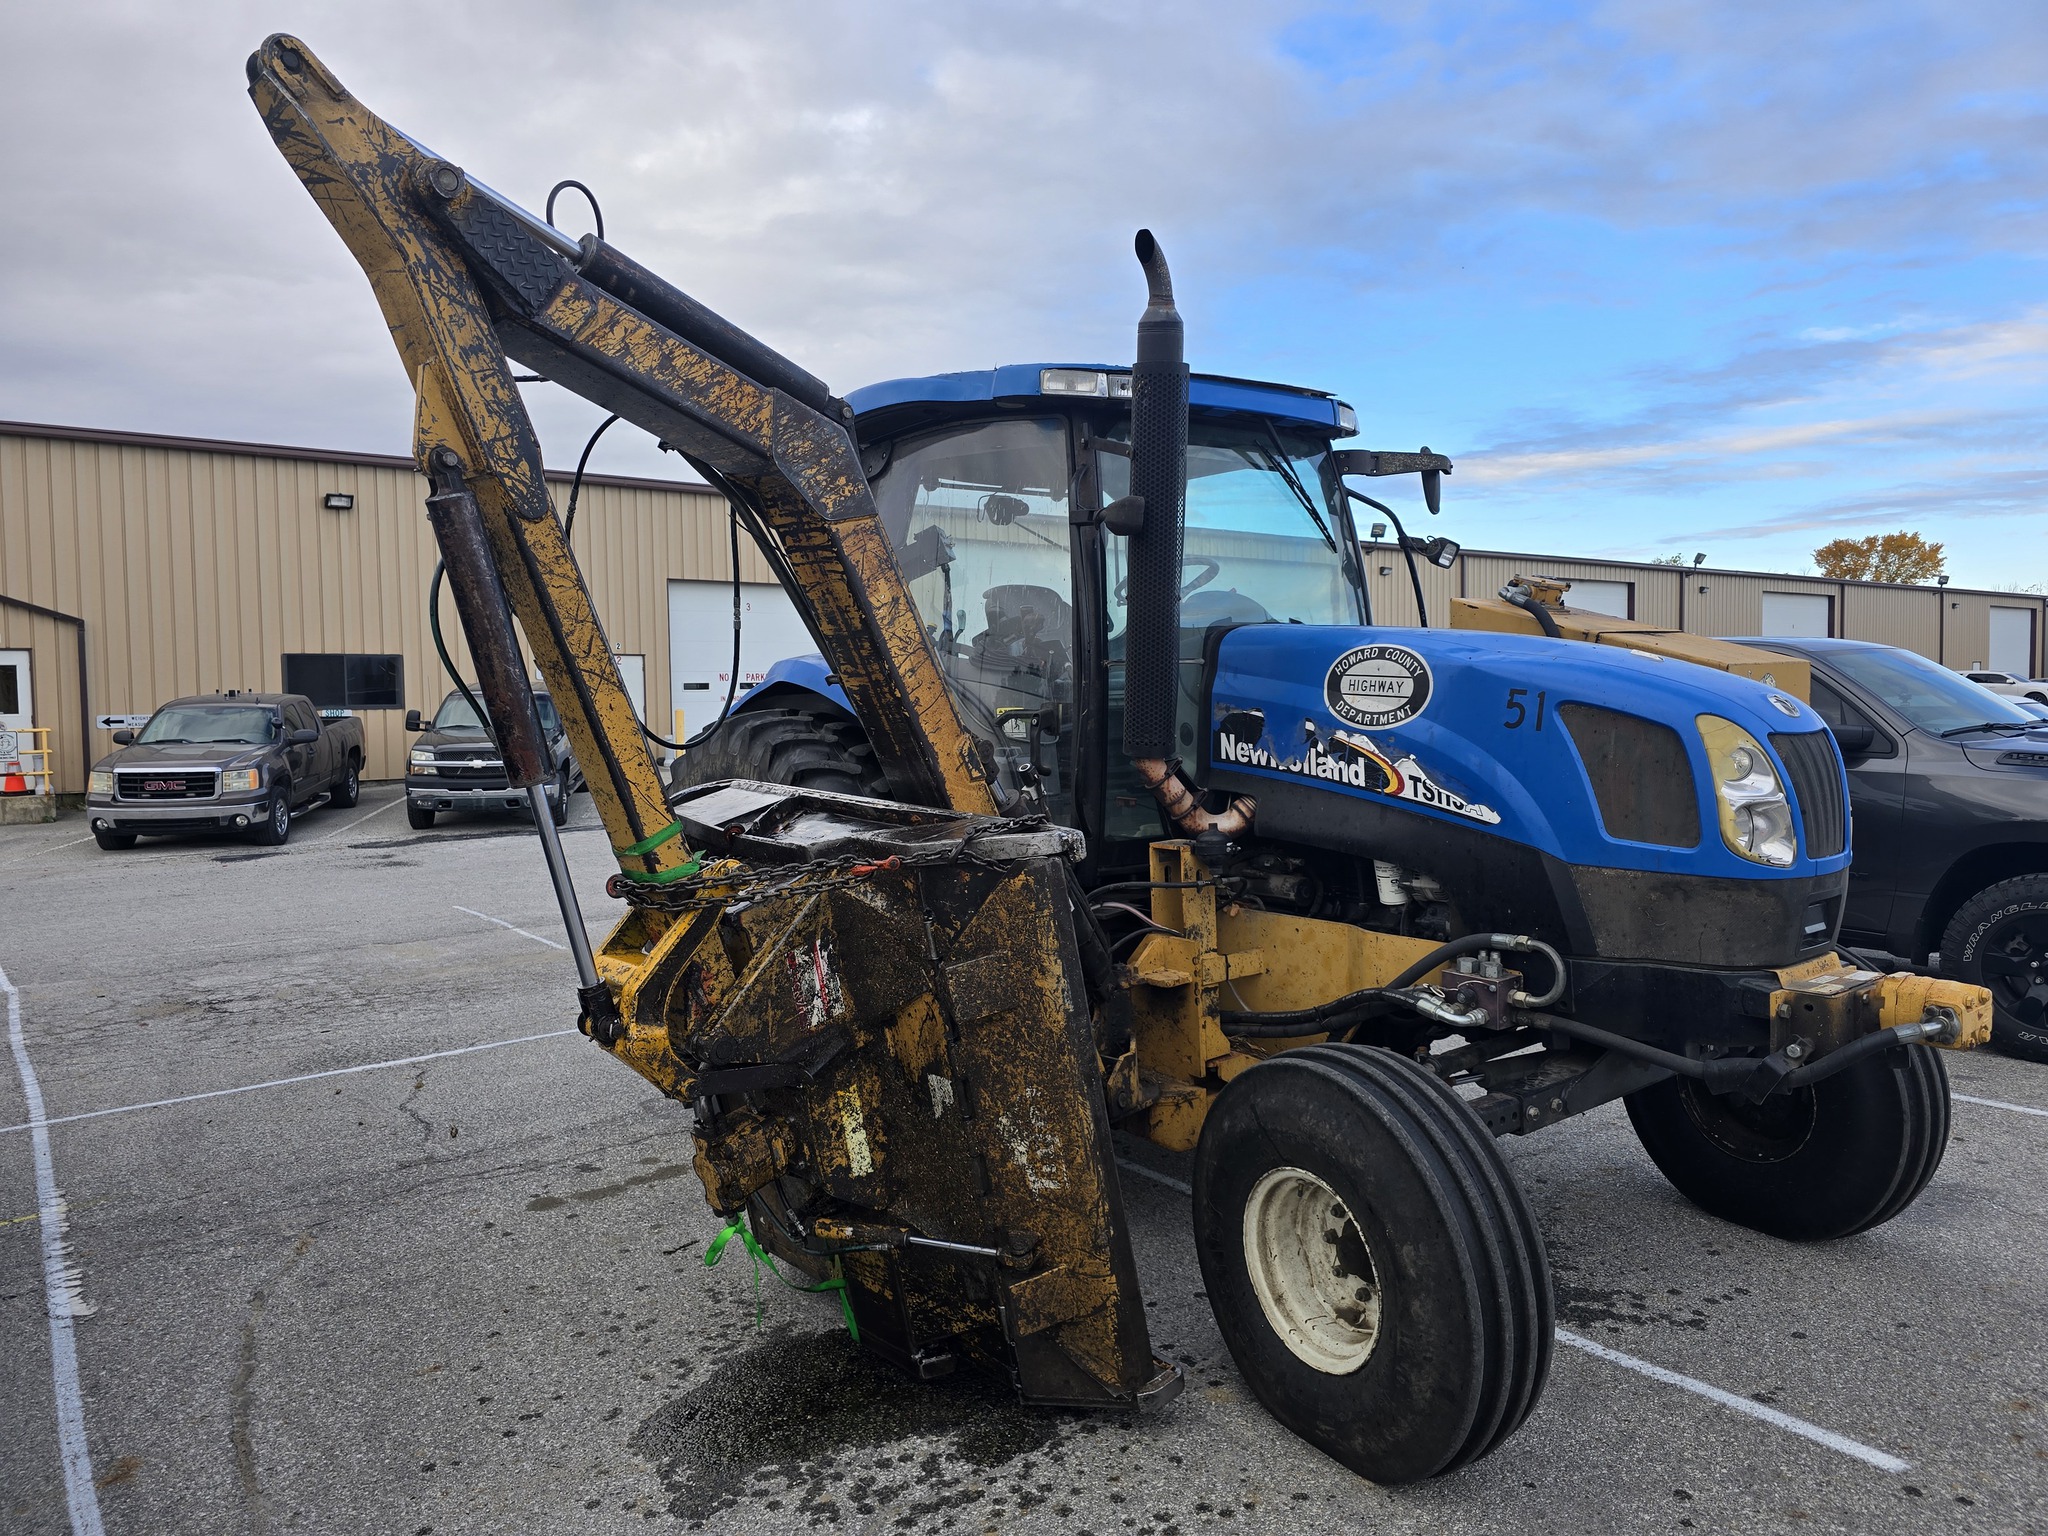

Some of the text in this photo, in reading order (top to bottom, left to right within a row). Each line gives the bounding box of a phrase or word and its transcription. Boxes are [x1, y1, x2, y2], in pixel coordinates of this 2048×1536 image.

[745, 602, 752, 612] 3
[616, 655, 622, 666] 2
[1334, 647, 1424, 677] HOWARD COUNTY
[719, 672, 730, 682] NO
[1348, 679, 1405, 694] HIGHWAY
[325, 708, 345, 718] SHOP
[1335, 700, 1412, 725] DEPARTMENT
[1503, 688, 1546, 732] 51
[144, 780, 187, 791] GMC
